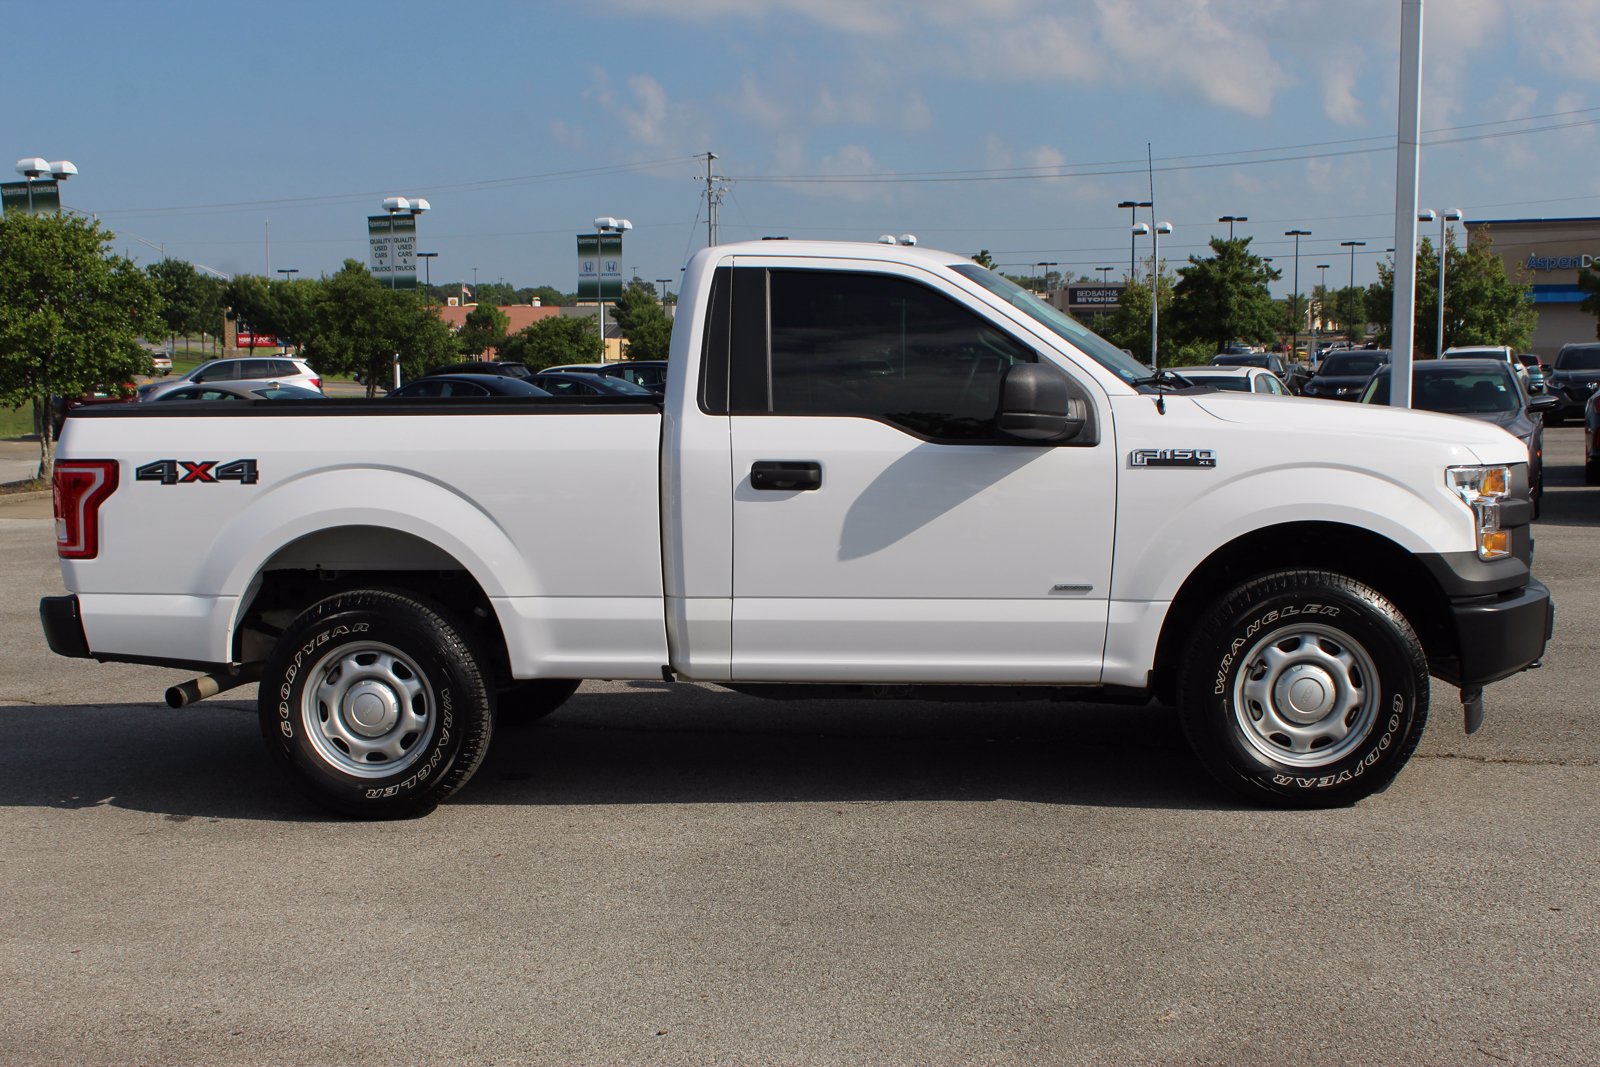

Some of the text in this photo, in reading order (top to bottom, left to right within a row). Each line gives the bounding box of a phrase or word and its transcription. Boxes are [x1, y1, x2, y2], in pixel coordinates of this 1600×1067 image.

[279, 622, 369, 738] GOODYEAR
[1214, 604, 1341, 695] WRANGLER
[365, 687, 453, 798] WRANGLER
[1272, 693, 1404, 788] GOODYEAR
